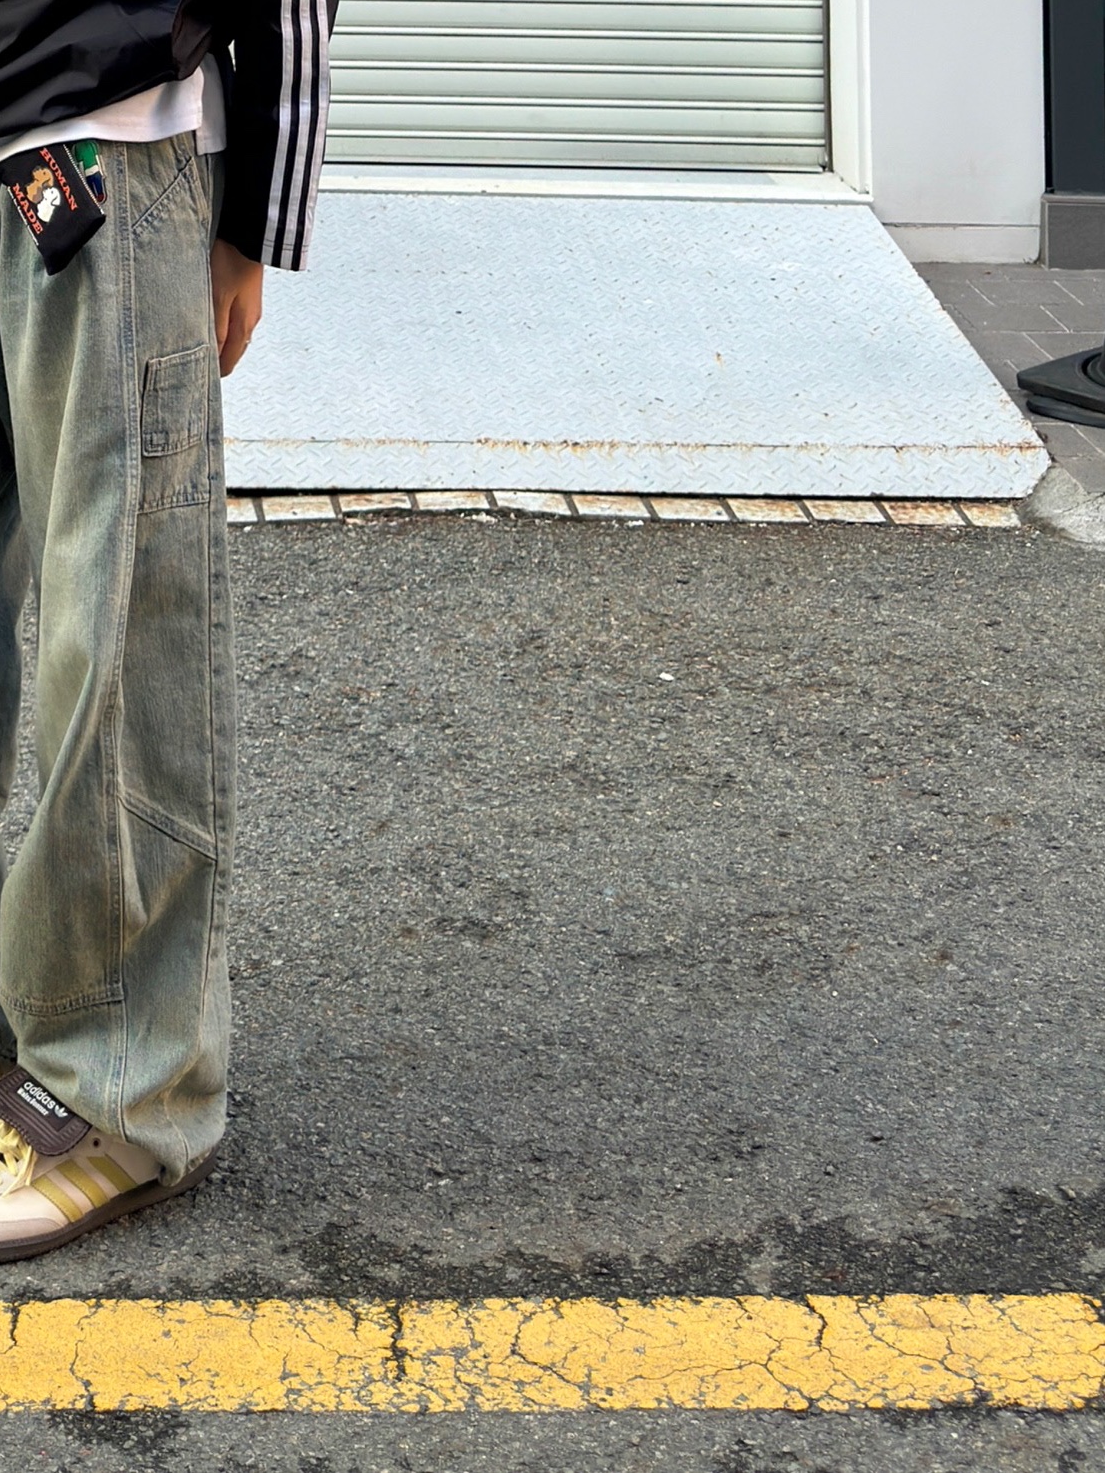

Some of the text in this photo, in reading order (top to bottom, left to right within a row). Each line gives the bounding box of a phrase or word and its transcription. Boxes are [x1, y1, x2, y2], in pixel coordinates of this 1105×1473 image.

[39, 147, 78, 211] HUMAN
[12, 182, 44, 235] MADE
[23, 1080, 56, 1110] adidas
